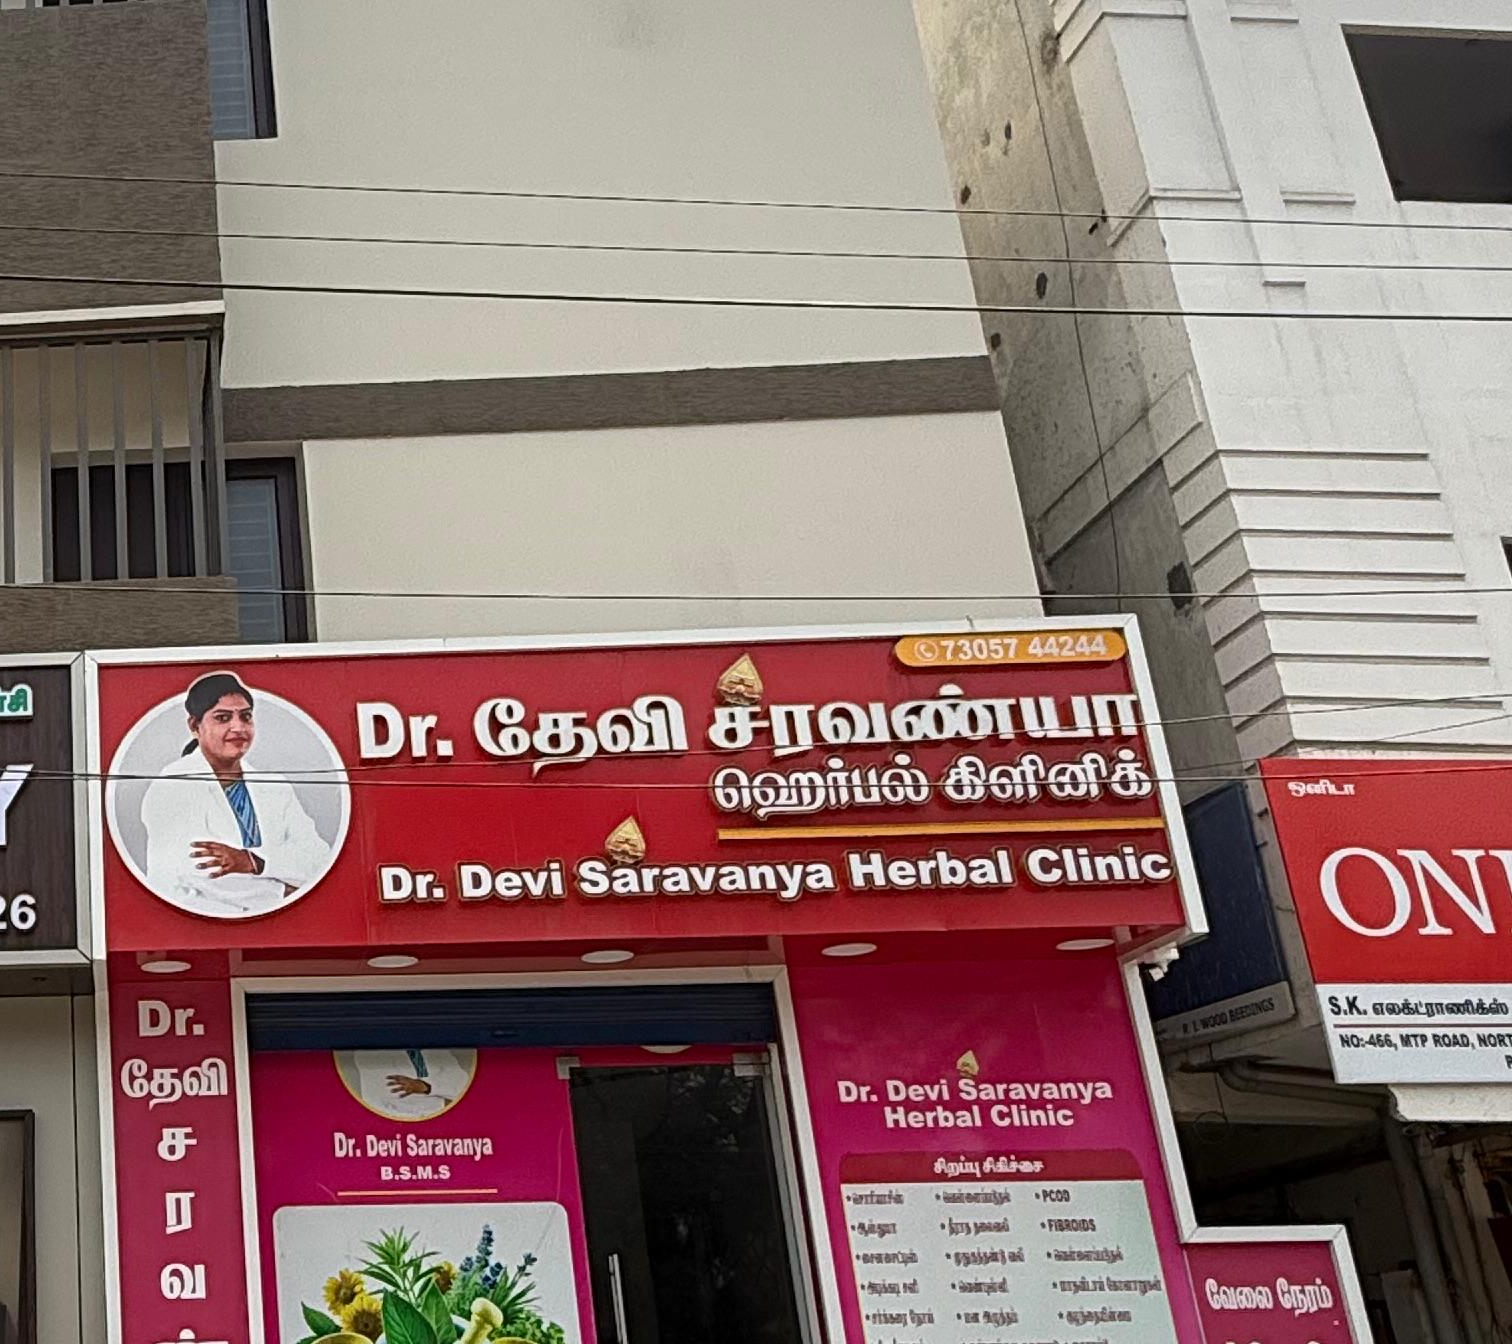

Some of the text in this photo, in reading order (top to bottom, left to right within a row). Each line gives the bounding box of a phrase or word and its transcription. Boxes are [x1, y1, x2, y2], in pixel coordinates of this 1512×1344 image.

[940, 633, 1108, 662] 73057 44244
[358, 701, 454, 763] Dr.
[473, 696, 688, 775] தேவி
[378, 845, 1172, 903] Dr. Devi Saravanya Herbal Clinic
[138, 1000, 206, 1038] Dr.
[1328, 995, 1368, 1016] S.K.
[1399, 1033, 1428, 1048] MTP
[1431, 1033, 1476, 1050] ROAD,
[120, 1057, 230, 1110] தேவி
[837, 1078, 1113, 1105] Dr. Devi Saravanya
[884, 1104, 1075, 1129] Herbal Clinic
[333, 1132, 494, 1161] Dr. Devi Saravanya
[380, 1165, 451, 1180] B.S.M.S
